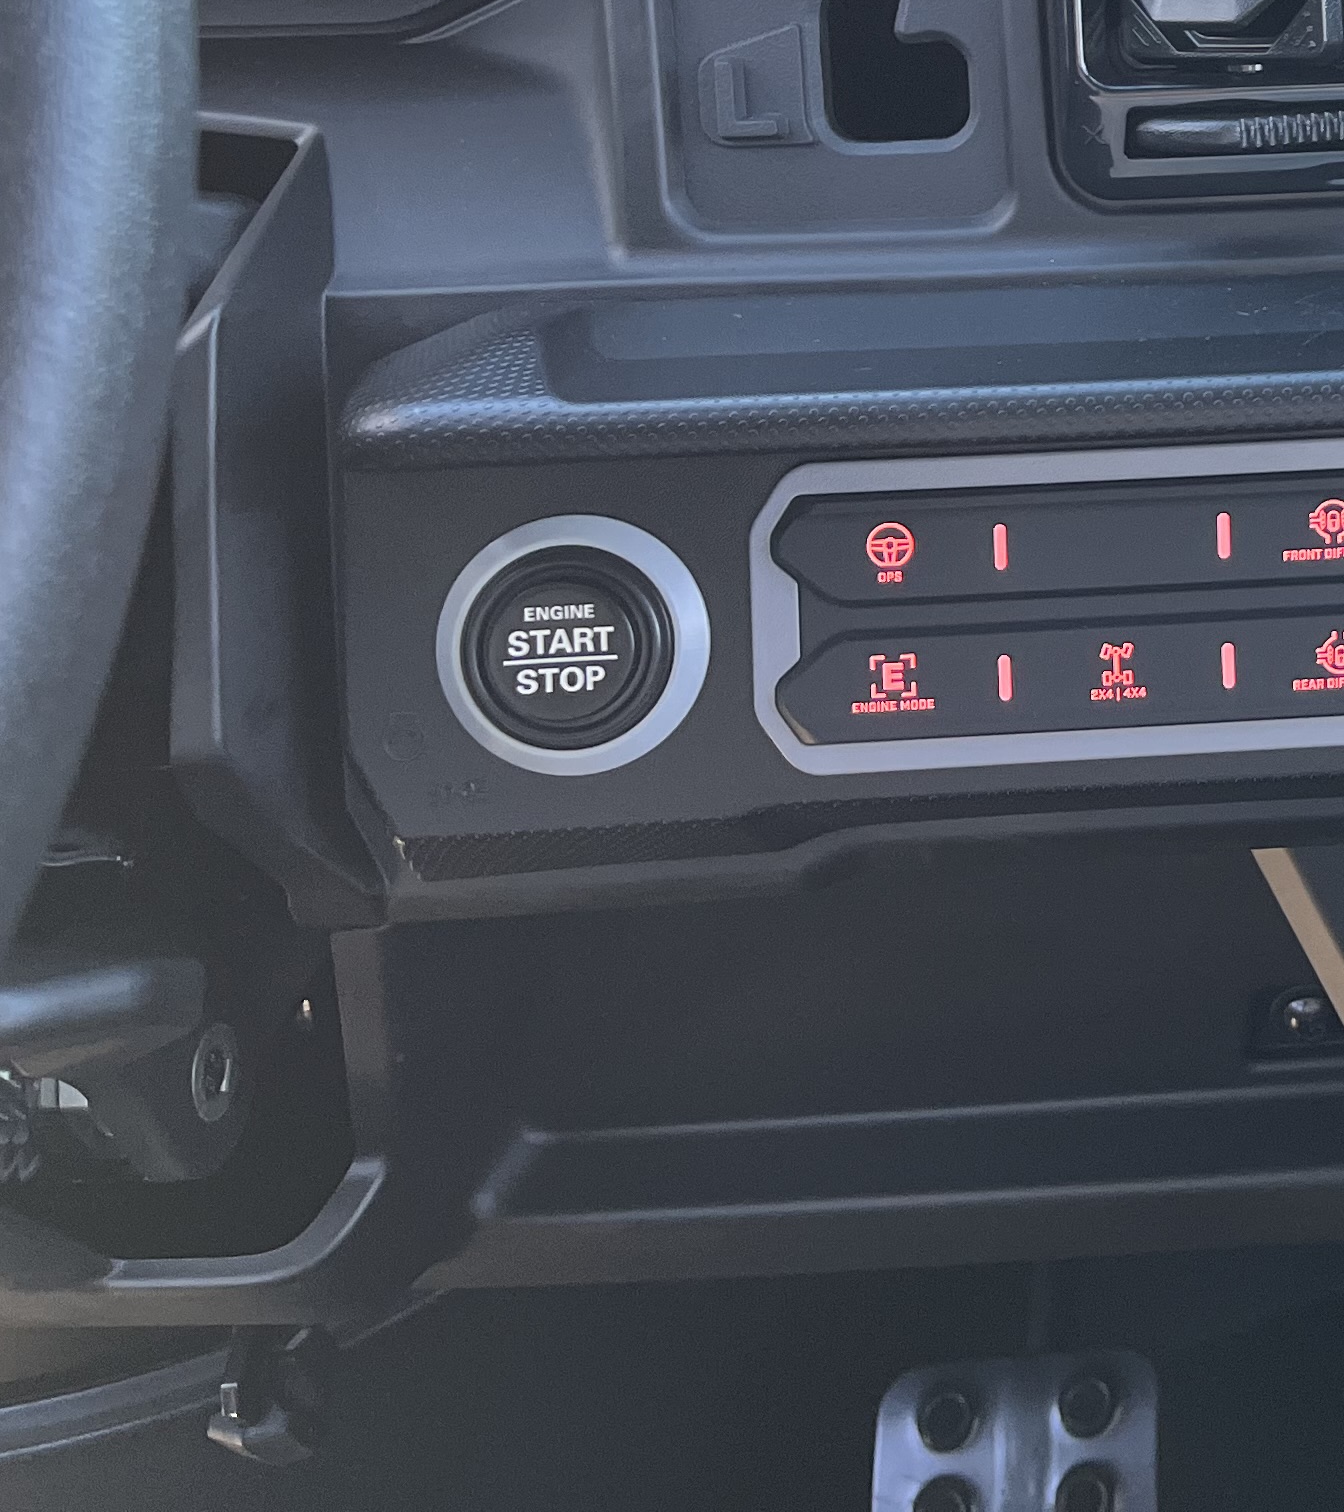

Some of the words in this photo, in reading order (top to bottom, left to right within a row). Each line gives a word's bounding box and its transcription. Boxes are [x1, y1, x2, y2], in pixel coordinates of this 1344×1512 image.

[714, 57, 789, 140] L
[1283, 549, 1323, 561] FRONT
[878, 571, 902, 583] OPS
[524, 604, 594, 621] ENGINE
[507, 626, 615, 655] START
[516, 666, 606, 695] STOP
[1293, 679, 1326, 691] REAR
[1122, 686, 1147, 698] 4X4
[851, 700, 898, 714] ENGINE
[899, 698, 936, 711] MODE
